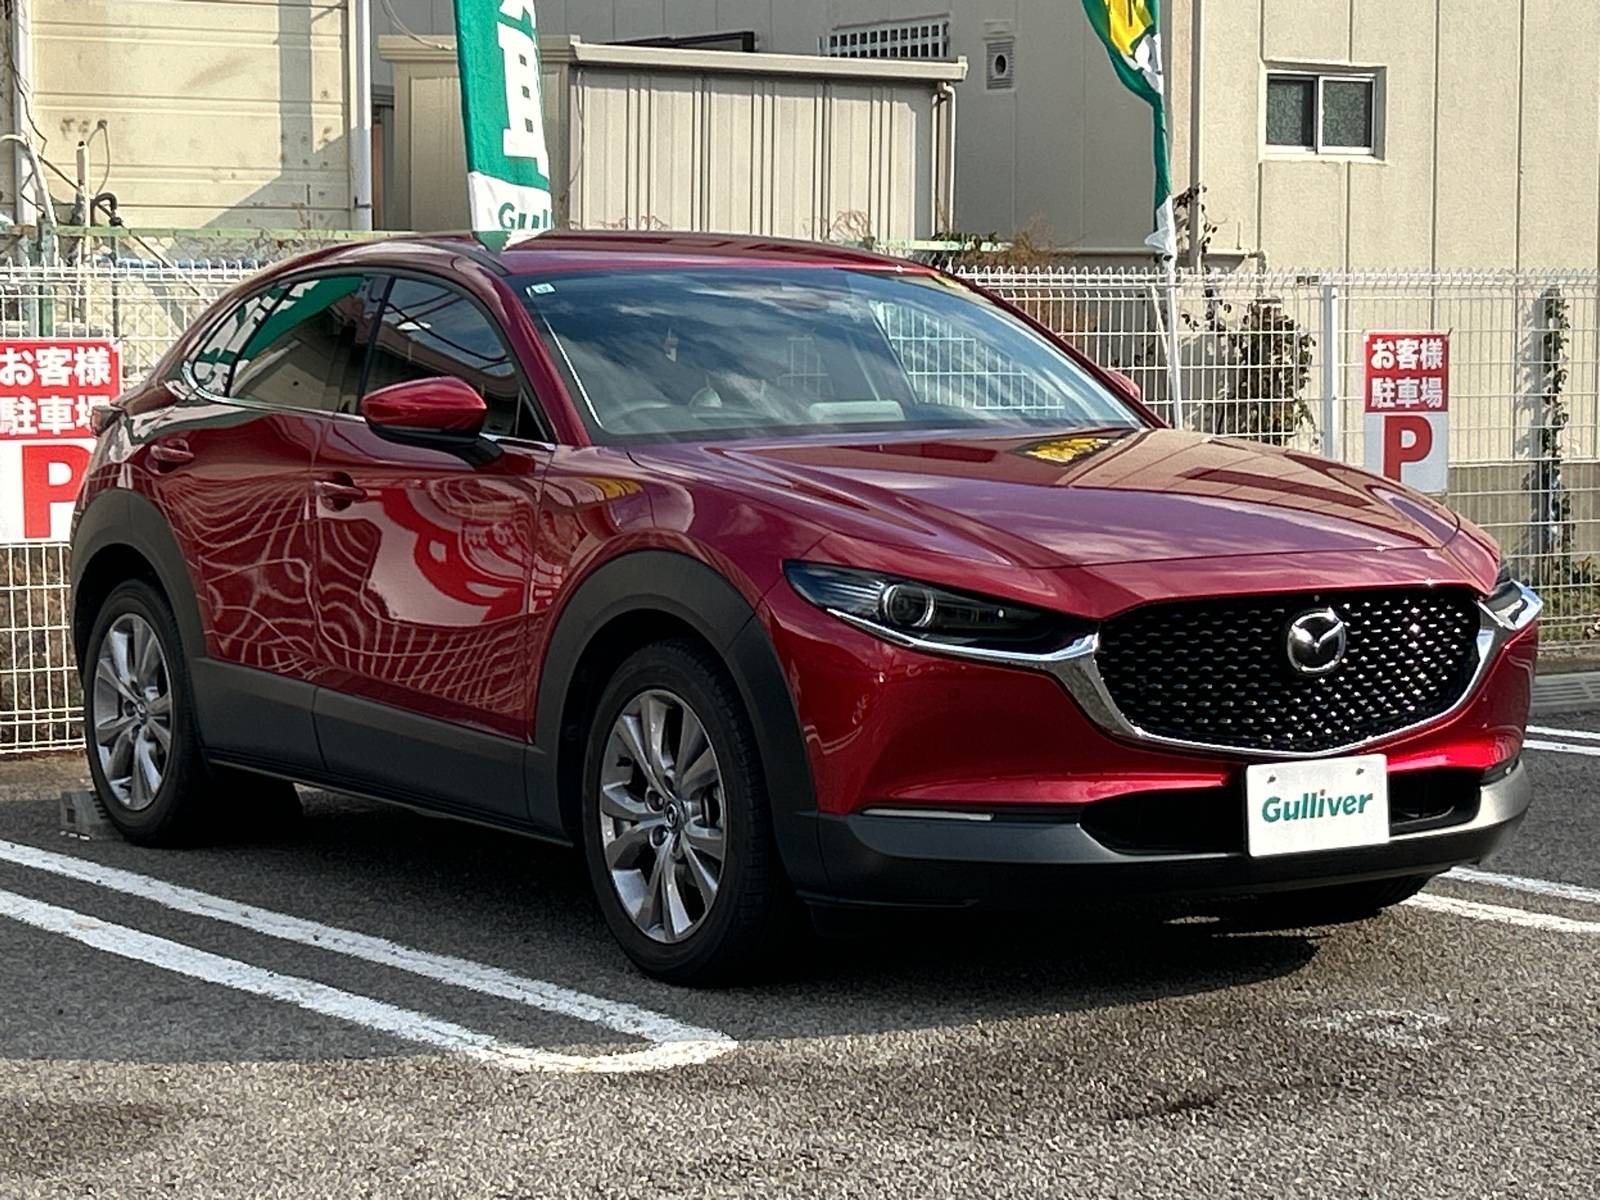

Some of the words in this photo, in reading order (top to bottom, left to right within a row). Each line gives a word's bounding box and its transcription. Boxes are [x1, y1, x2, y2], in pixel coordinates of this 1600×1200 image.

[0, 346, 111, 387] お客様
[1370, 338, 1443, 370] お客様
[1370, 377, 1443, 409] 駐車場
[1383, 415, 1433, 483] P
[22, 444, 93, 539] P
[1261, 789, 1374, 823] Gulliver
